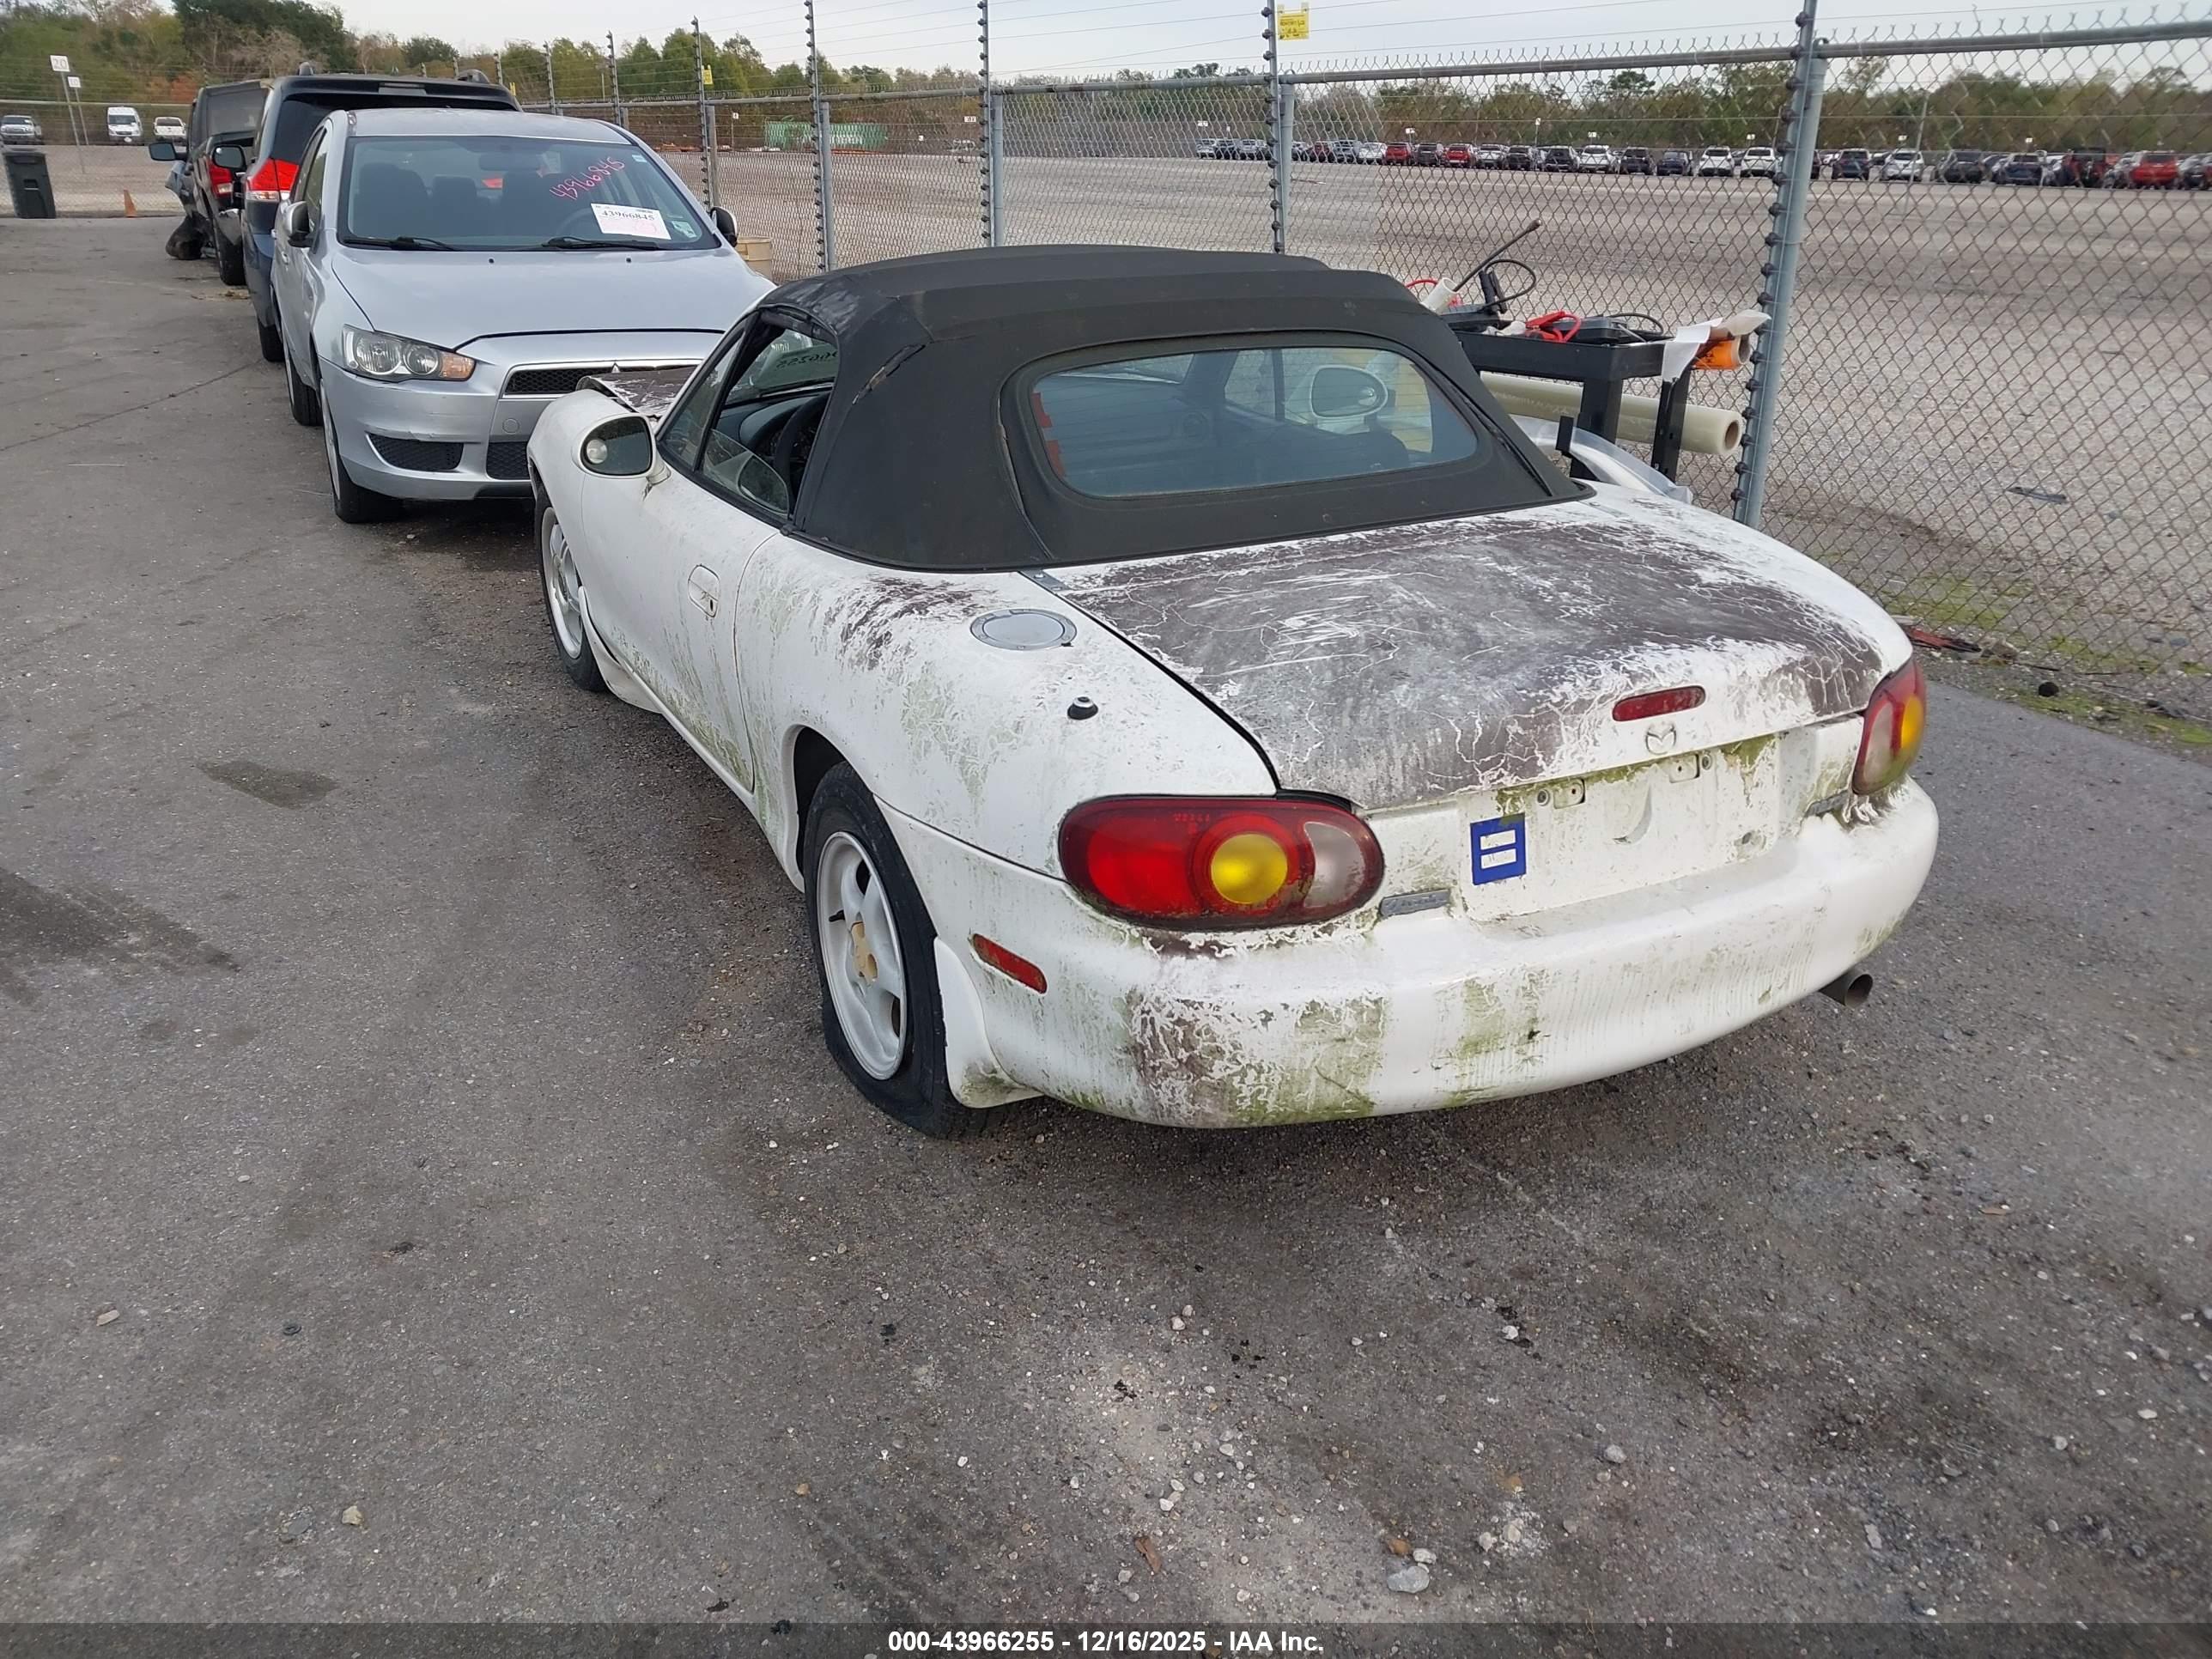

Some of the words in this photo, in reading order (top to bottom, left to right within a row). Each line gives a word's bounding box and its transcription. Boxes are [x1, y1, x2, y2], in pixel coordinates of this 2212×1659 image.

[52, 58, 67, 70] 20
[549, 155, 625, 200] 43966845
[601, 210, 655, 221] 43966845
